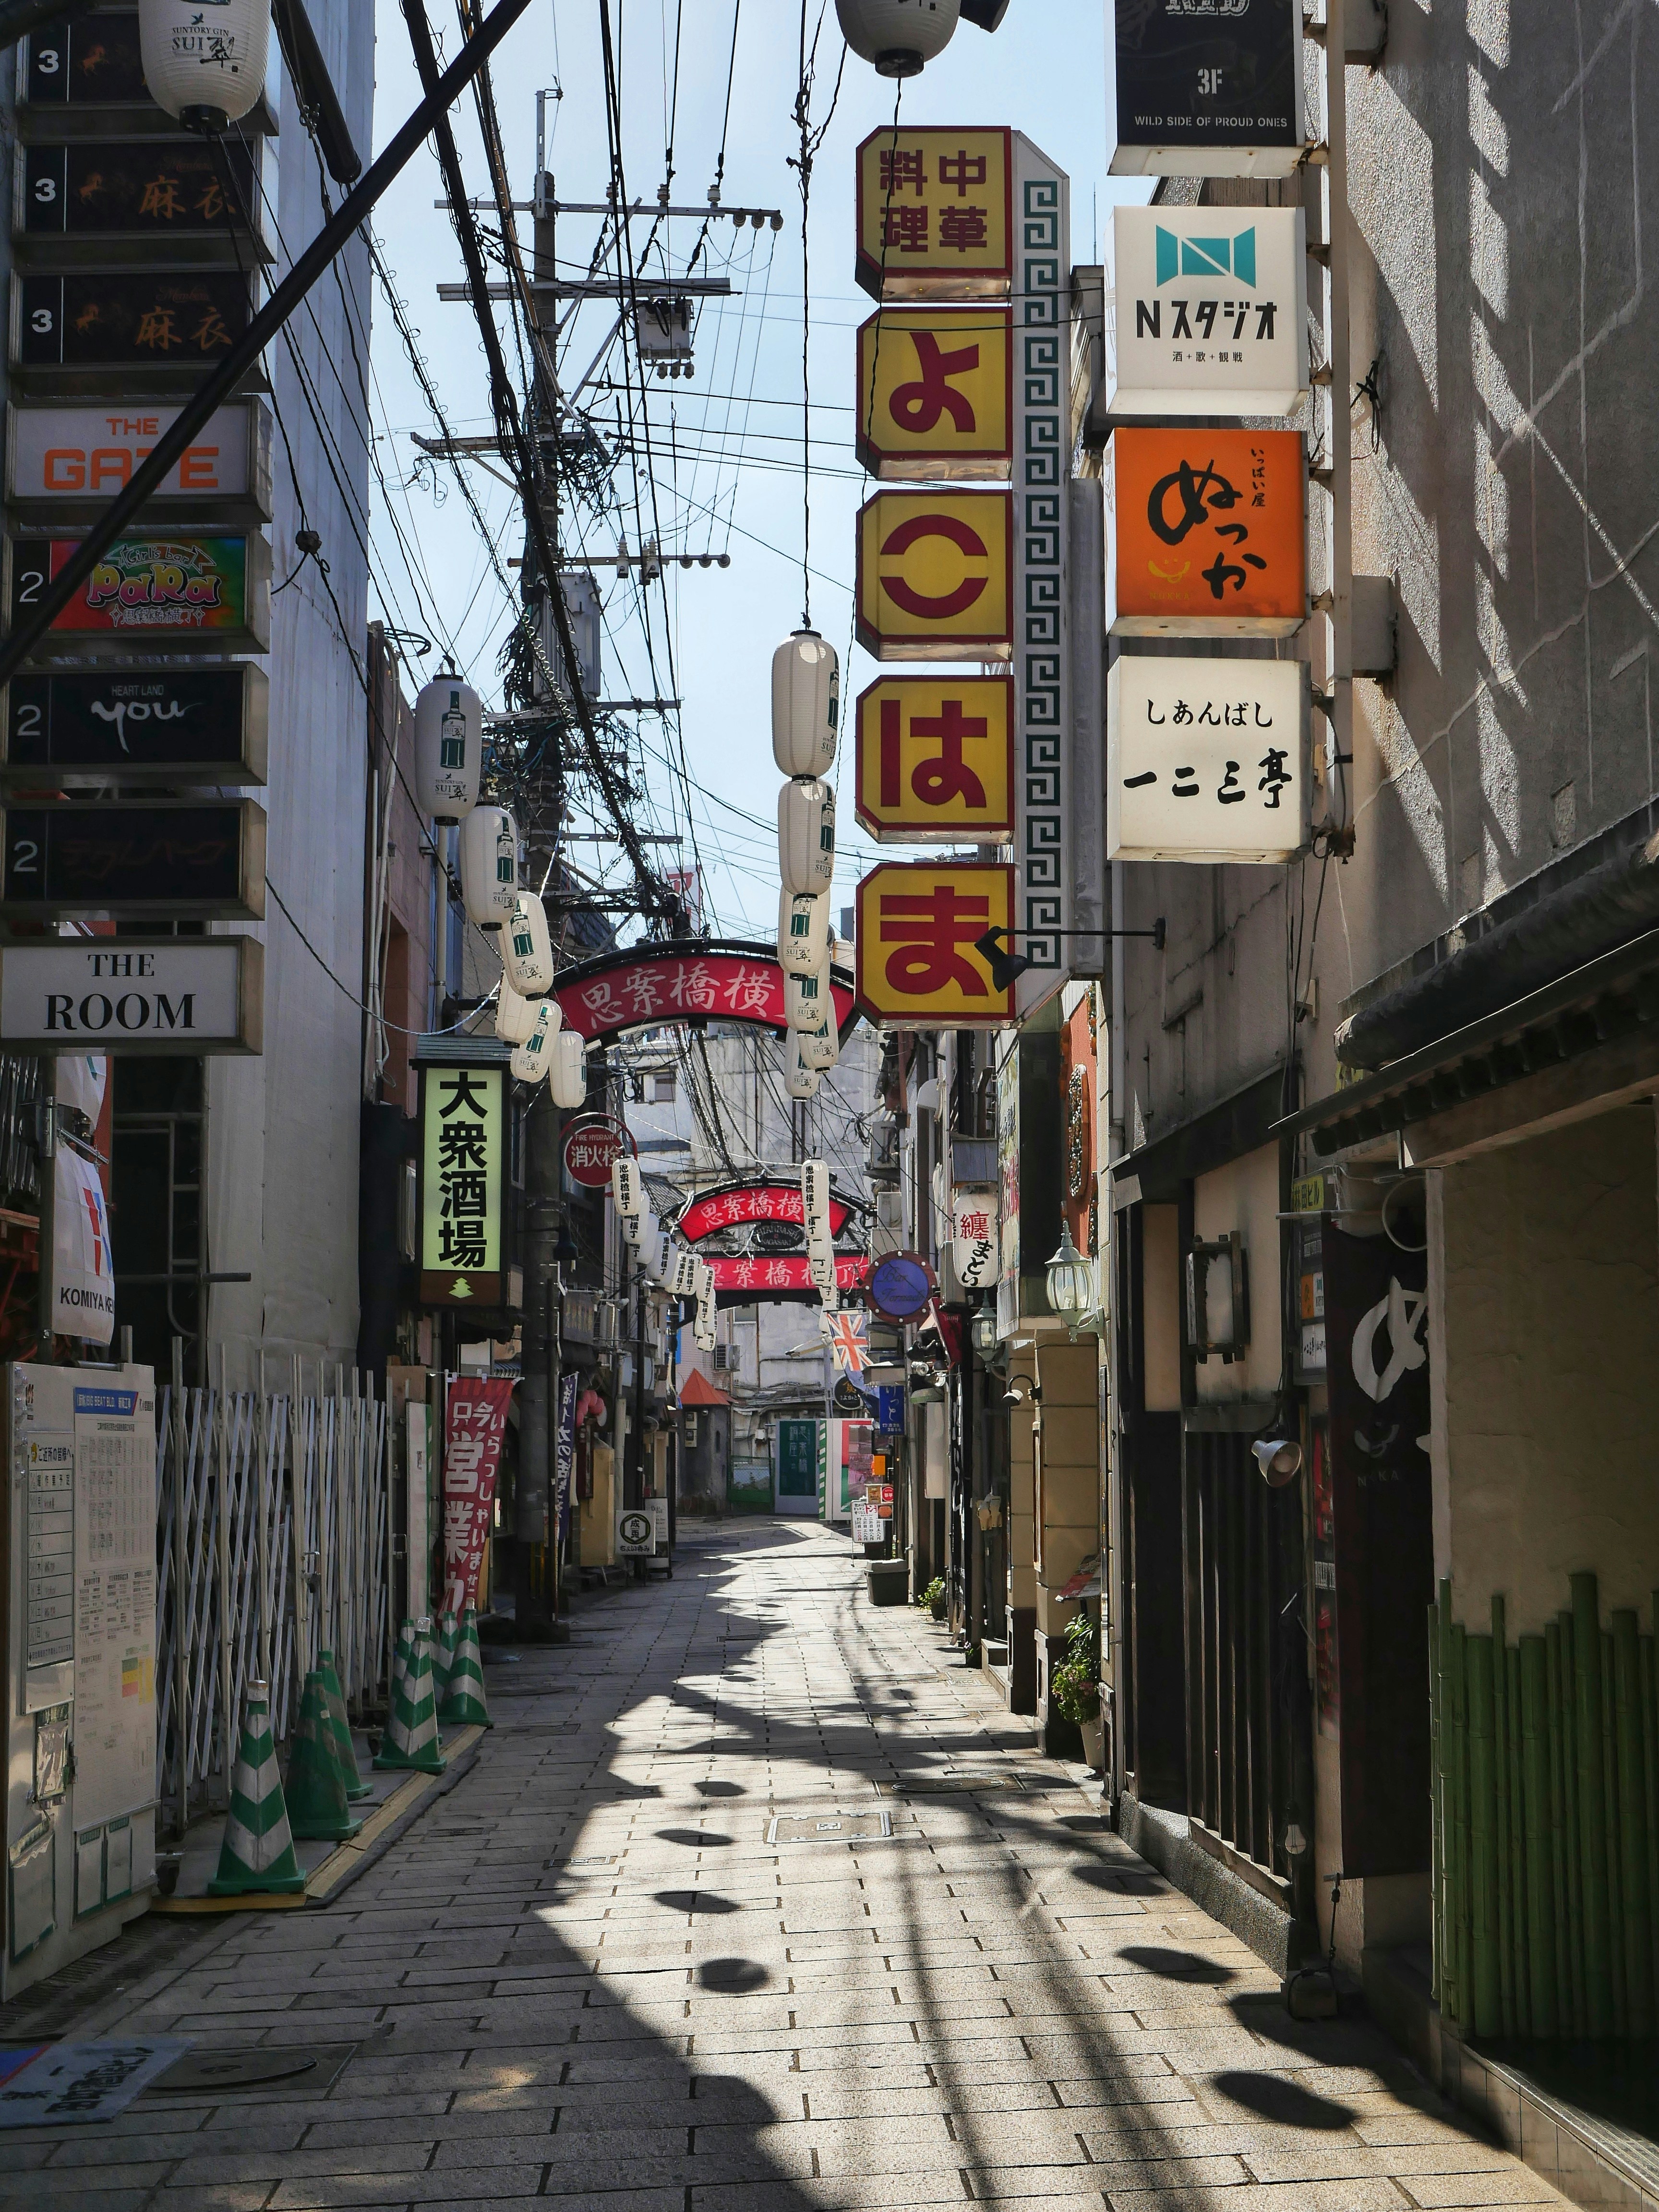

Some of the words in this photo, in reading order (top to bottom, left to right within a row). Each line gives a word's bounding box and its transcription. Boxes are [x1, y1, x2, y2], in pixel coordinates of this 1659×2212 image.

[172, 36, 203, 50] SUI
[38, 50, 59, 73] 3
[1197, 68, 1223, 95] 3F
[1135, 116, 1163, 126] WILD
[1167, 116, 1192, 127] SIDE
[1196, 116, 1211, 127] OF
[1215, 117, 1253, 127] PROUD
[1258, 117, 1287, 127] ONES
[36, 179, 56, 201] 3
[139, 175, 236, 219] 麻衣
[880, 149, 928, 252] 料理
[939, 150, 987, 252] 中華
[32, 310, 52, 333] 3
[135, 306, 232, 350] 麻衣
[1136, 300, 1277, 340] Nスタジオ
[107, 418, 158, 434] THE
[1250, 447, 1266, 508] いっぱい屋
[1147, 459, 1266, 600] ぬっか
[126, 546, 160, 563] Girl's
[165, 547, 190, 563] bar
[19, 572, 43, 602] 2
[111, 685, 140, 696] HEART
[141, 685, 164, 696] LAND
[17, 705, 41, 736] 2
[1147, 699, 1273, 728] しあんばし
[1123, 747, 1292, 808] 一二三亭
[13, 841, 38, 872] 2
[87, 954, 155, 977] THE
[581, 962, 787, 1029] 思案橋横
[44, 994, 196, 1030] ROOM
[438, 1071, 487, 1268] 大衆酒場
[700, 1191, 804, 1229] 思案橋横
[962, 1240, 994, 1286] まとい
[60, 1286, 104, 1311] KOMIYA
[94, 1395, 106, 1407] BEAT
[468, 1412, 505, 1592] いらっしゃいませ
